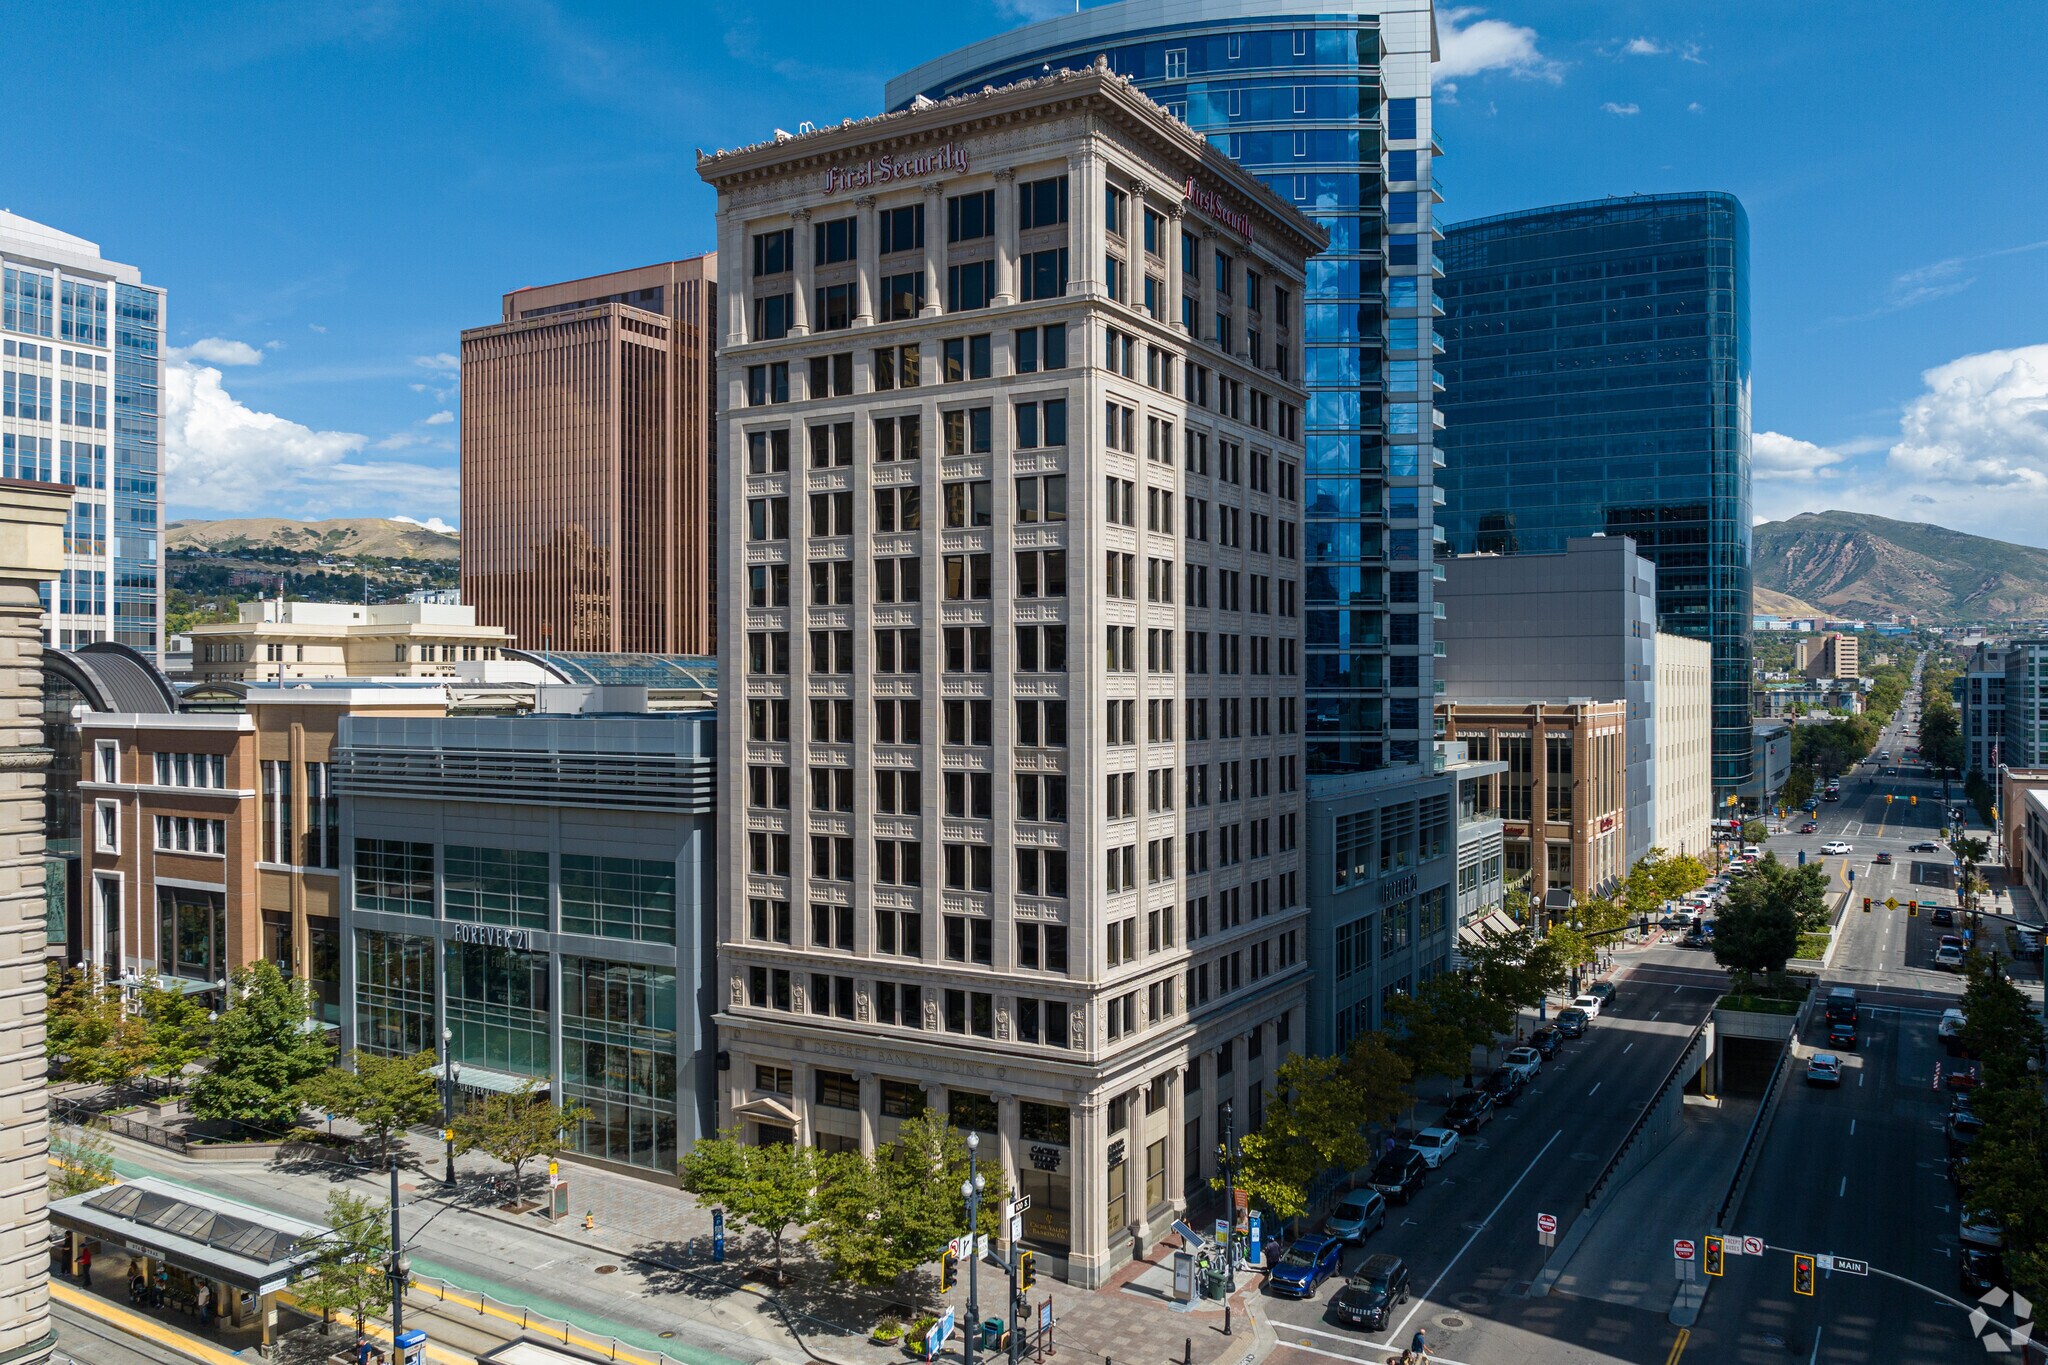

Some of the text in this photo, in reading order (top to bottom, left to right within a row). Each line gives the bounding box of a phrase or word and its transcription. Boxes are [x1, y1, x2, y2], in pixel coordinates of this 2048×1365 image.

[823, 141, 970, 195] First Security
[1185, 176, 1213, 213] First
[455, 924, 529, 950] FOREVER 21
[814, 1042, 984, 1077] DESERET BANK BUILDING
[1031, 1145, 1060, 1157] CACHE
[1029, 1153, 1062, 1166] VALLEY
[1033, 1160, 1057, 1173] BANK
[1015, 1202, 1024, 1212] 100
[1838, 1260, 1861, 1272] MAIN
